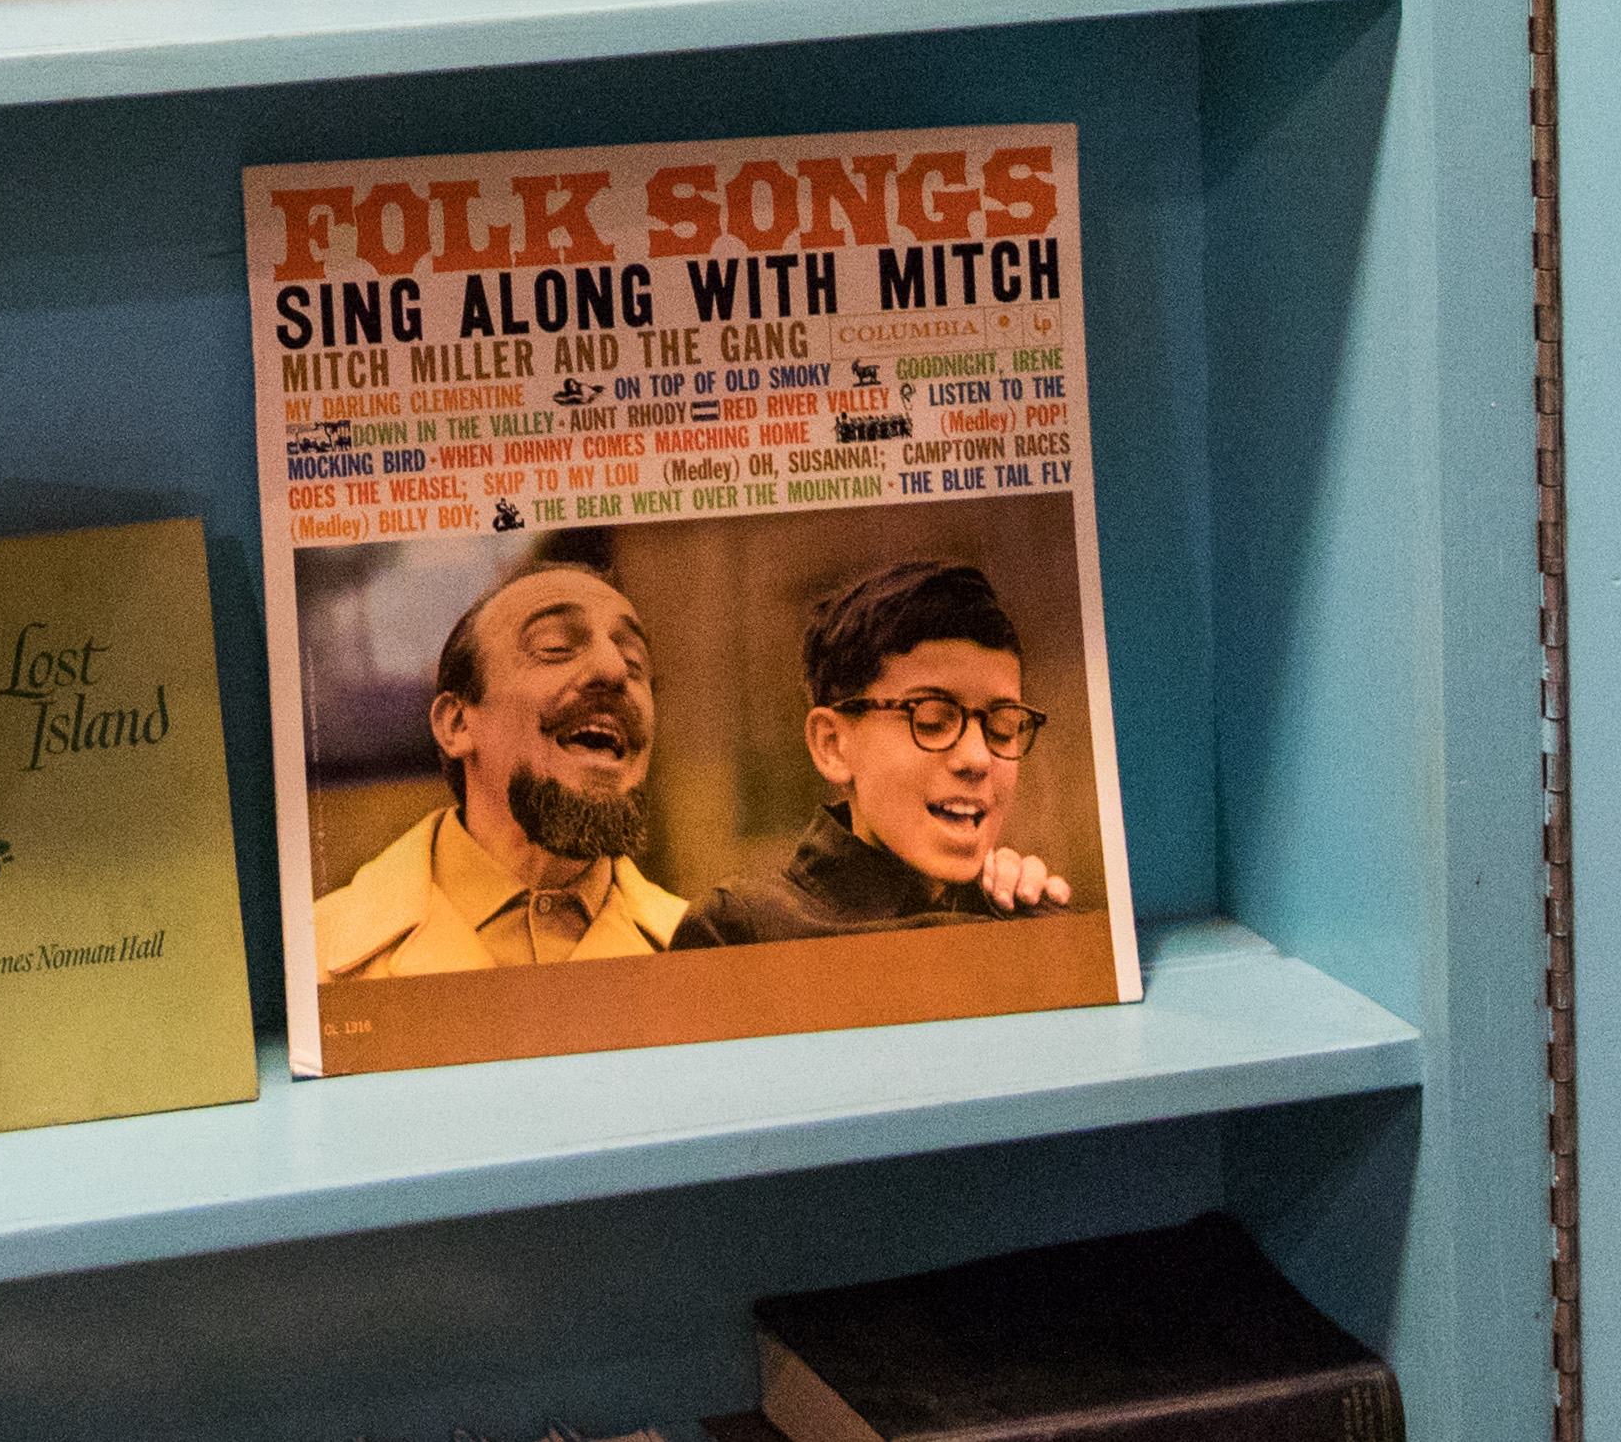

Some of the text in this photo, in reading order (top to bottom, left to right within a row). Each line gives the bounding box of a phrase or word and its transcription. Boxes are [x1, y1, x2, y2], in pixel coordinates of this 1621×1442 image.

[270, 146, 1058, 282] FOLK SONGS
[275, 238, 1060, 350] SING ALONG WITH MITCH
[282, 321, 809, 393] MITCH MILLER AND THE GANG
[838, 318, 979, 344] COLUMBIA
[614, 363, 832, 400] ON TOP OF OLD SMOKY
[899, 460, 1073, 494] THE BLUE TAIL FLY
[27, 685, 171, 773] Island
[35, 939, 115, 975] Norman
[119, 931, 166, 968] Hall
